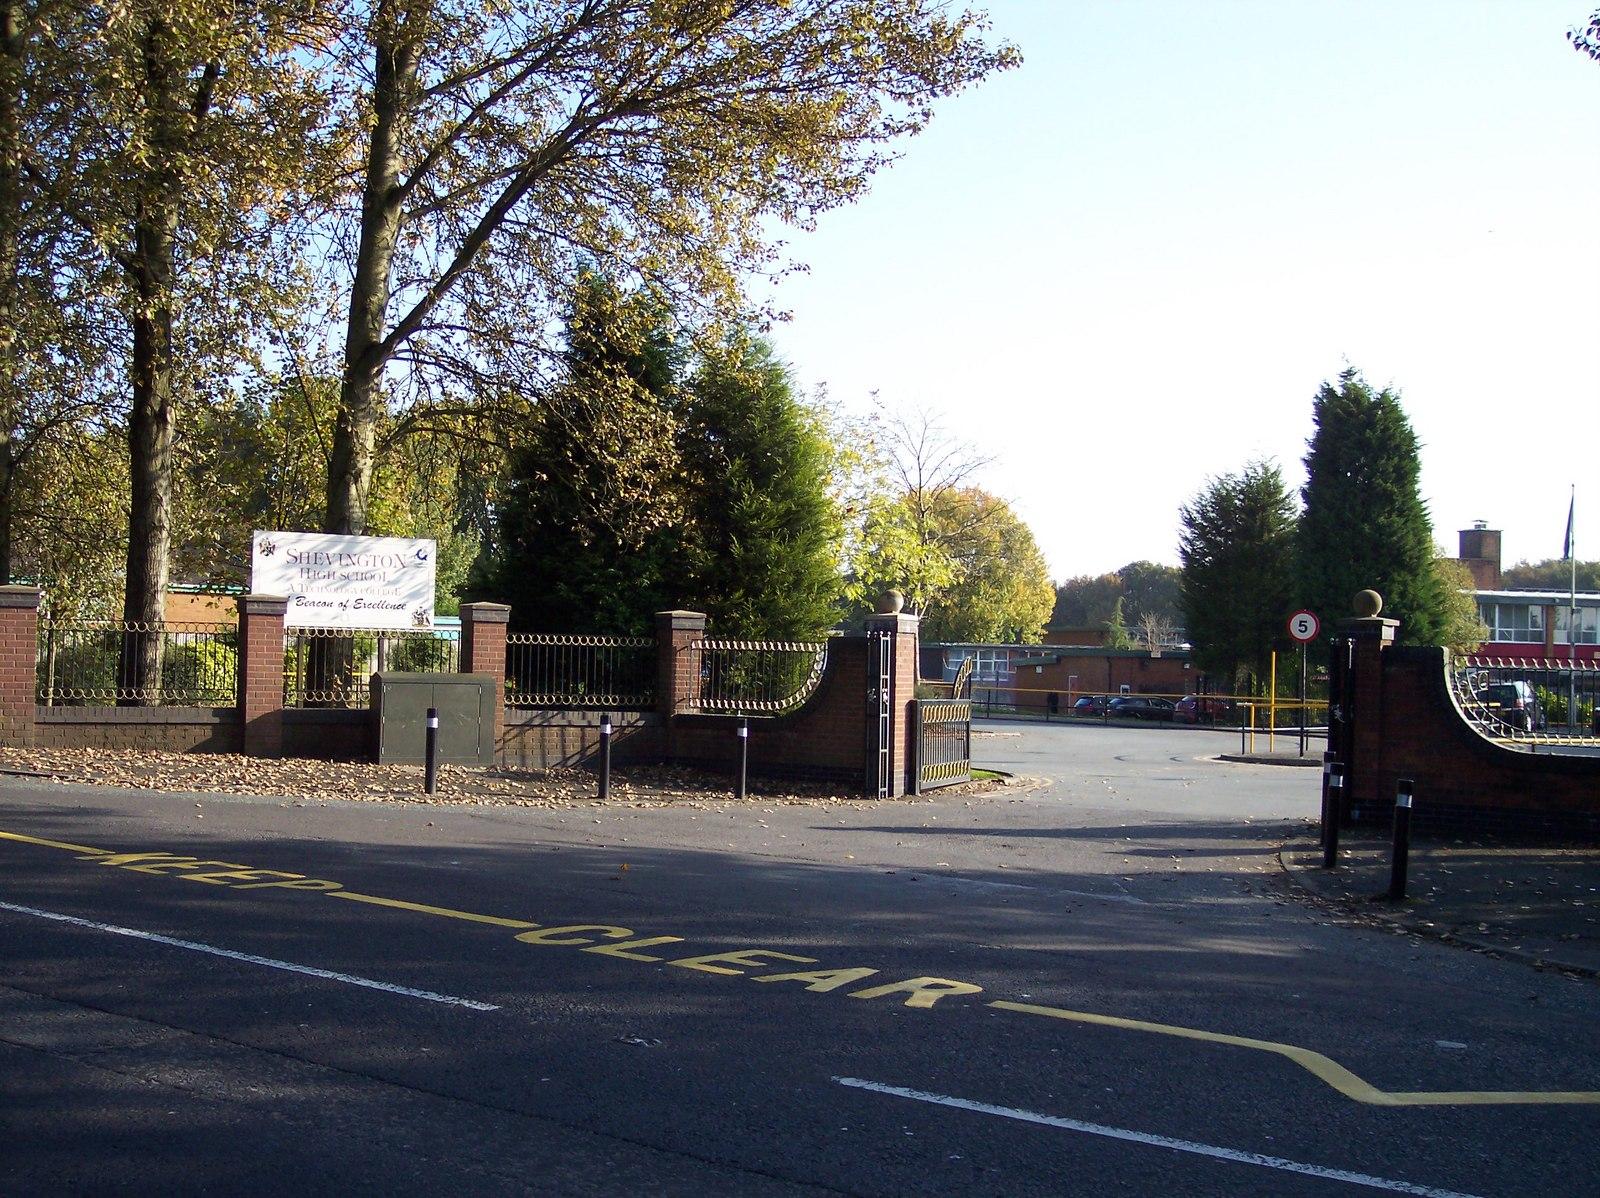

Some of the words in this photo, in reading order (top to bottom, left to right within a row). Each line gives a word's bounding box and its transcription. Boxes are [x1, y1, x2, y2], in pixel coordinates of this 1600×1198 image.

[286, 548, 407, 569] SHEVINGTON
[300, 567, 337, 580] HIGH
[340, 570, 390, 583] SCHOOL
[295, 595, 334, 608] Beacon
[338, 599, 350, 611] of
[353, 598, 407, 611] Excellence
[1298, 620, 1308, 633] 5
[75, 852, 343, 889] KEEP
[514, 925, 983, 1008] CLEAR
